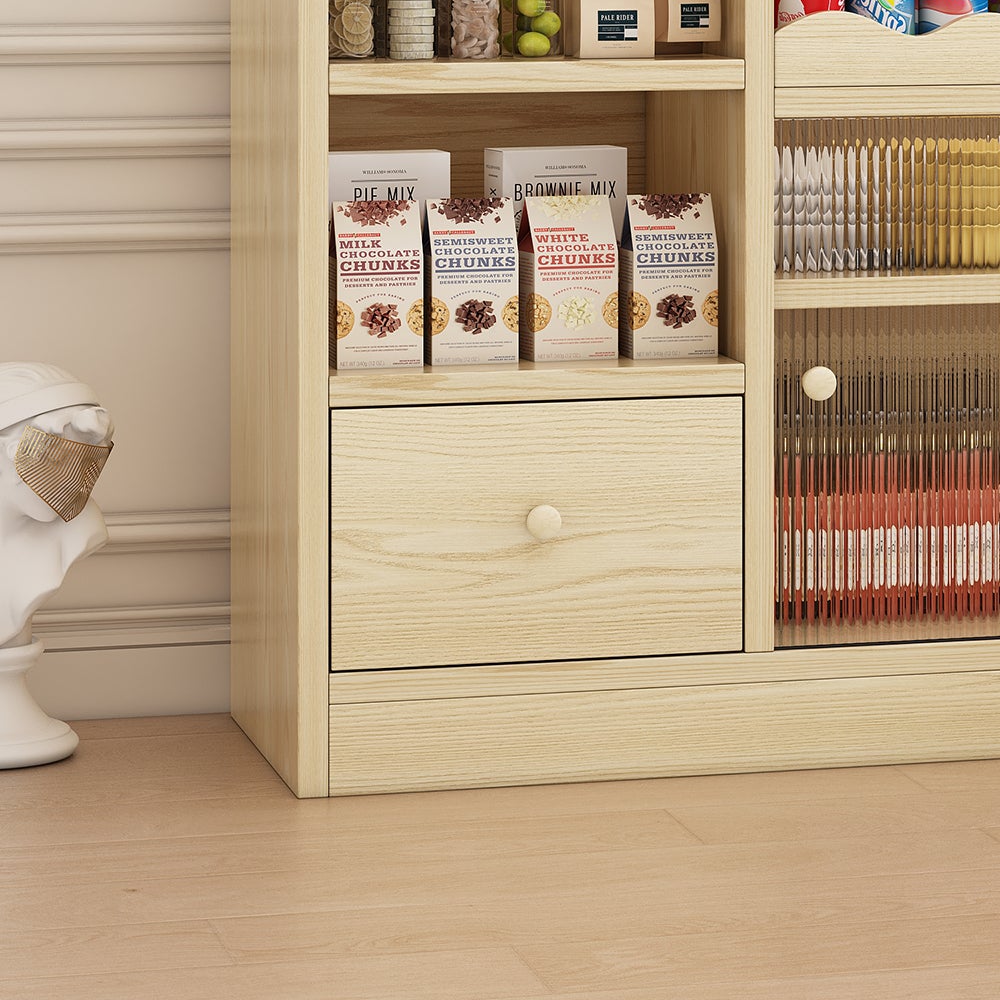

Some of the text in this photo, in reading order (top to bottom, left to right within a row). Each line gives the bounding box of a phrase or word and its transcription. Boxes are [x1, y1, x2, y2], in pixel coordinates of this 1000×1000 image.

[387, 186, 415, 201] MIX
[514, 180, 616, 201] BROWNIE MIX
[535, 234, 589, 243] WHITE
[635, 233, 712, 241] SEMISWEET
[340, 240, 382, 249] MILK
[434, 238, 513, 246] SEMISWEET
[636, 242, 715, 250] CHOCOLATE
[434, 247, 515, 255] CHOCOLATE
[537, 244, 615, 252] CHOCOLATE
[340, 250, 420, 258] CHOCOLATE
[637, 252, 715, 263] CHUNKS
[435, 256, 516, 268] CHUNKS
[538, 253, 615, 265] CHUNKS
[340, 260, 420, 271] CHUNKS
